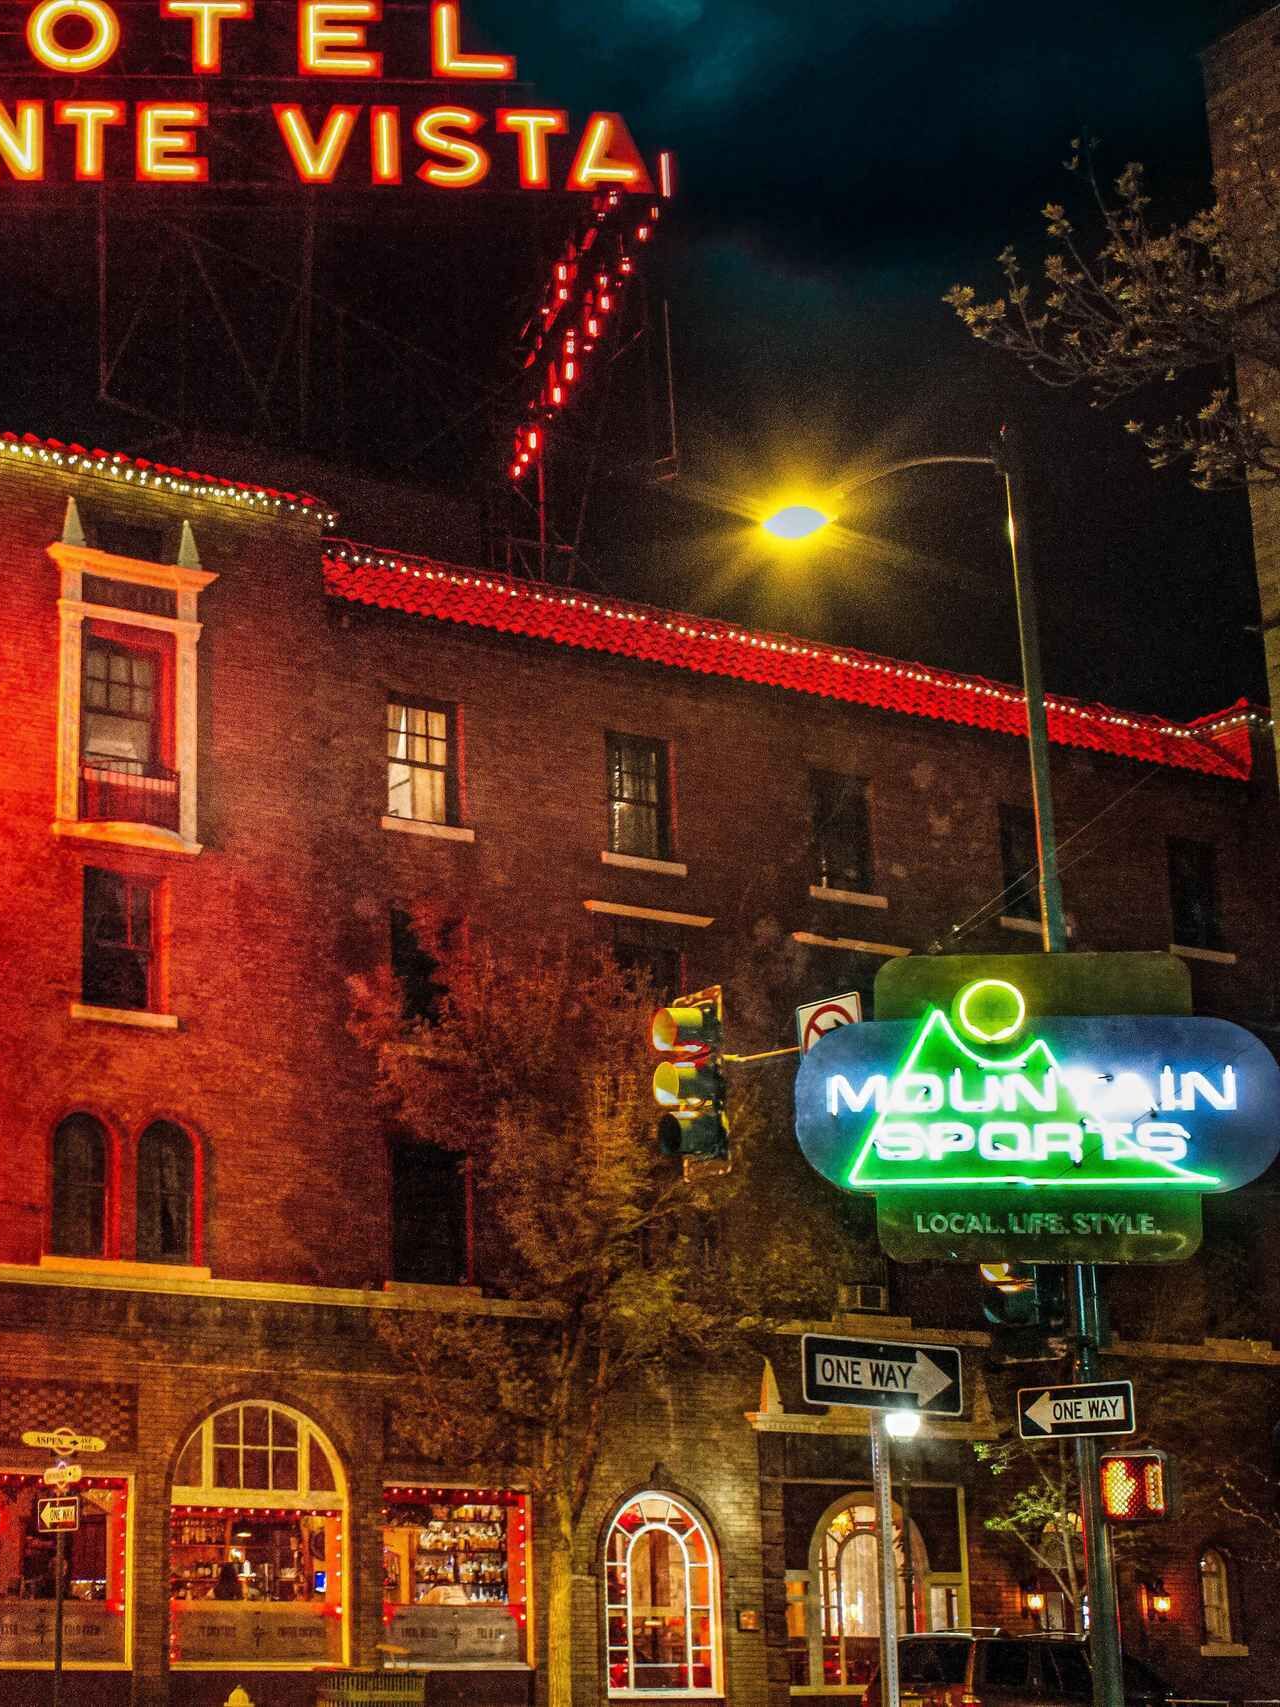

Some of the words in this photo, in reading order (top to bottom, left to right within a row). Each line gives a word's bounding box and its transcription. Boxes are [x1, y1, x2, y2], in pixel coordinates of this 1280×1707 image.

[273, 104, 653, 192] VISTA
[826, 1066, 1238, 1115] MOUNTAIN
[875, 1122, 1191, 1163] SPORTS
[915, 1213, 1007, 1234] LOCAL.
[1010, 1213, 1070, 1235] LIFE.
[1073, 1213, 1162, 1236] STYLE.
[821, 1358, 862, 1385] ONE
[869, 1363, 912, 1389] WAY
[1053, 1401, 1083, 1421] ONE
[1087, 1399, 1119, 1418] WAY
[37, 1436, 64, 1446] ASPEN
[49, 1510, 61, 1522] ONE
